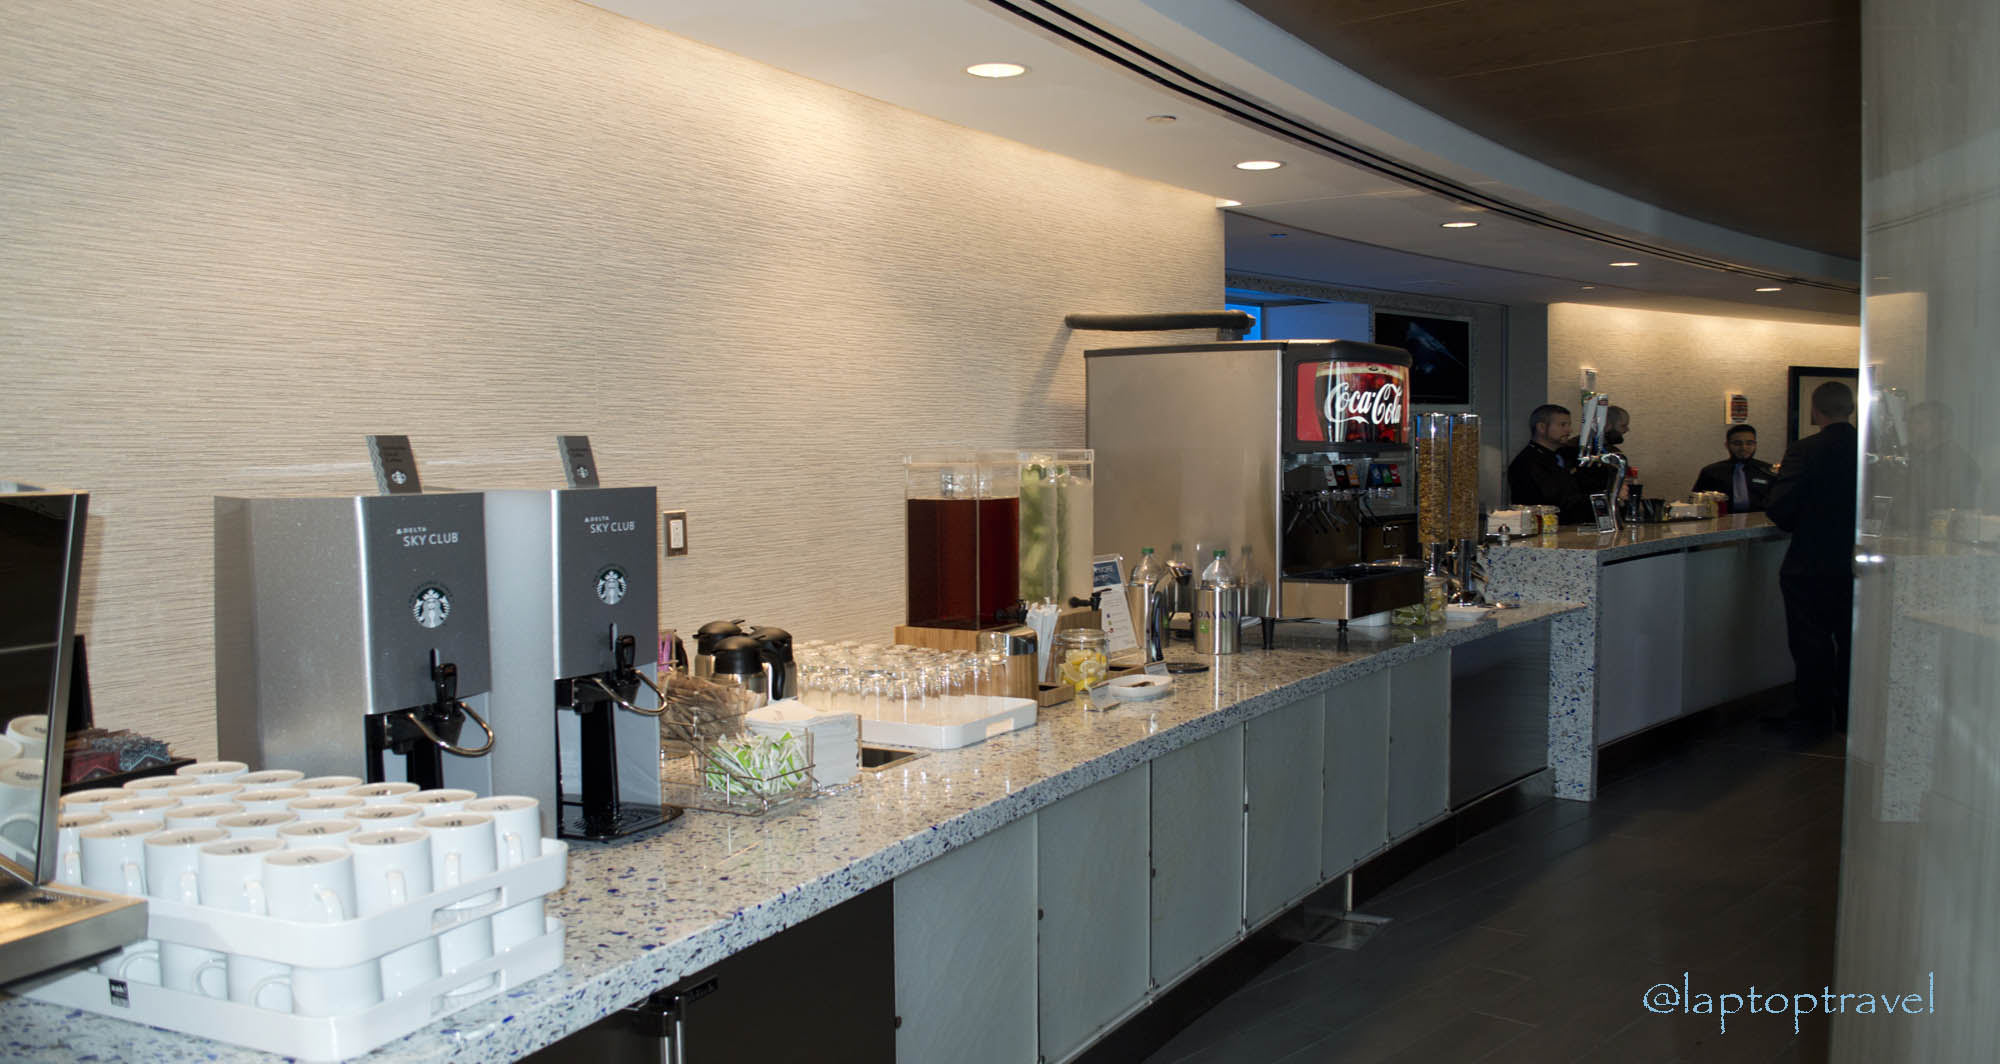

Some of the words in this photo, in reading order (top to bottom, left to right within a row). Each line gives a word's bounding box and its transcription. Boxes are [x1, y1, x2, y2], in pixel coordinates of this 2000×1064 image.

[1324, 382, 1402, 425] Coca-Cola
[402, 526, 427, 534] DELTA
[590, 522, 608, 534] SKY
[610, 520, 636, 532] CLUB
[402, 535, 427, 547] SKY
[428, 532, 459, 545] CLUB
